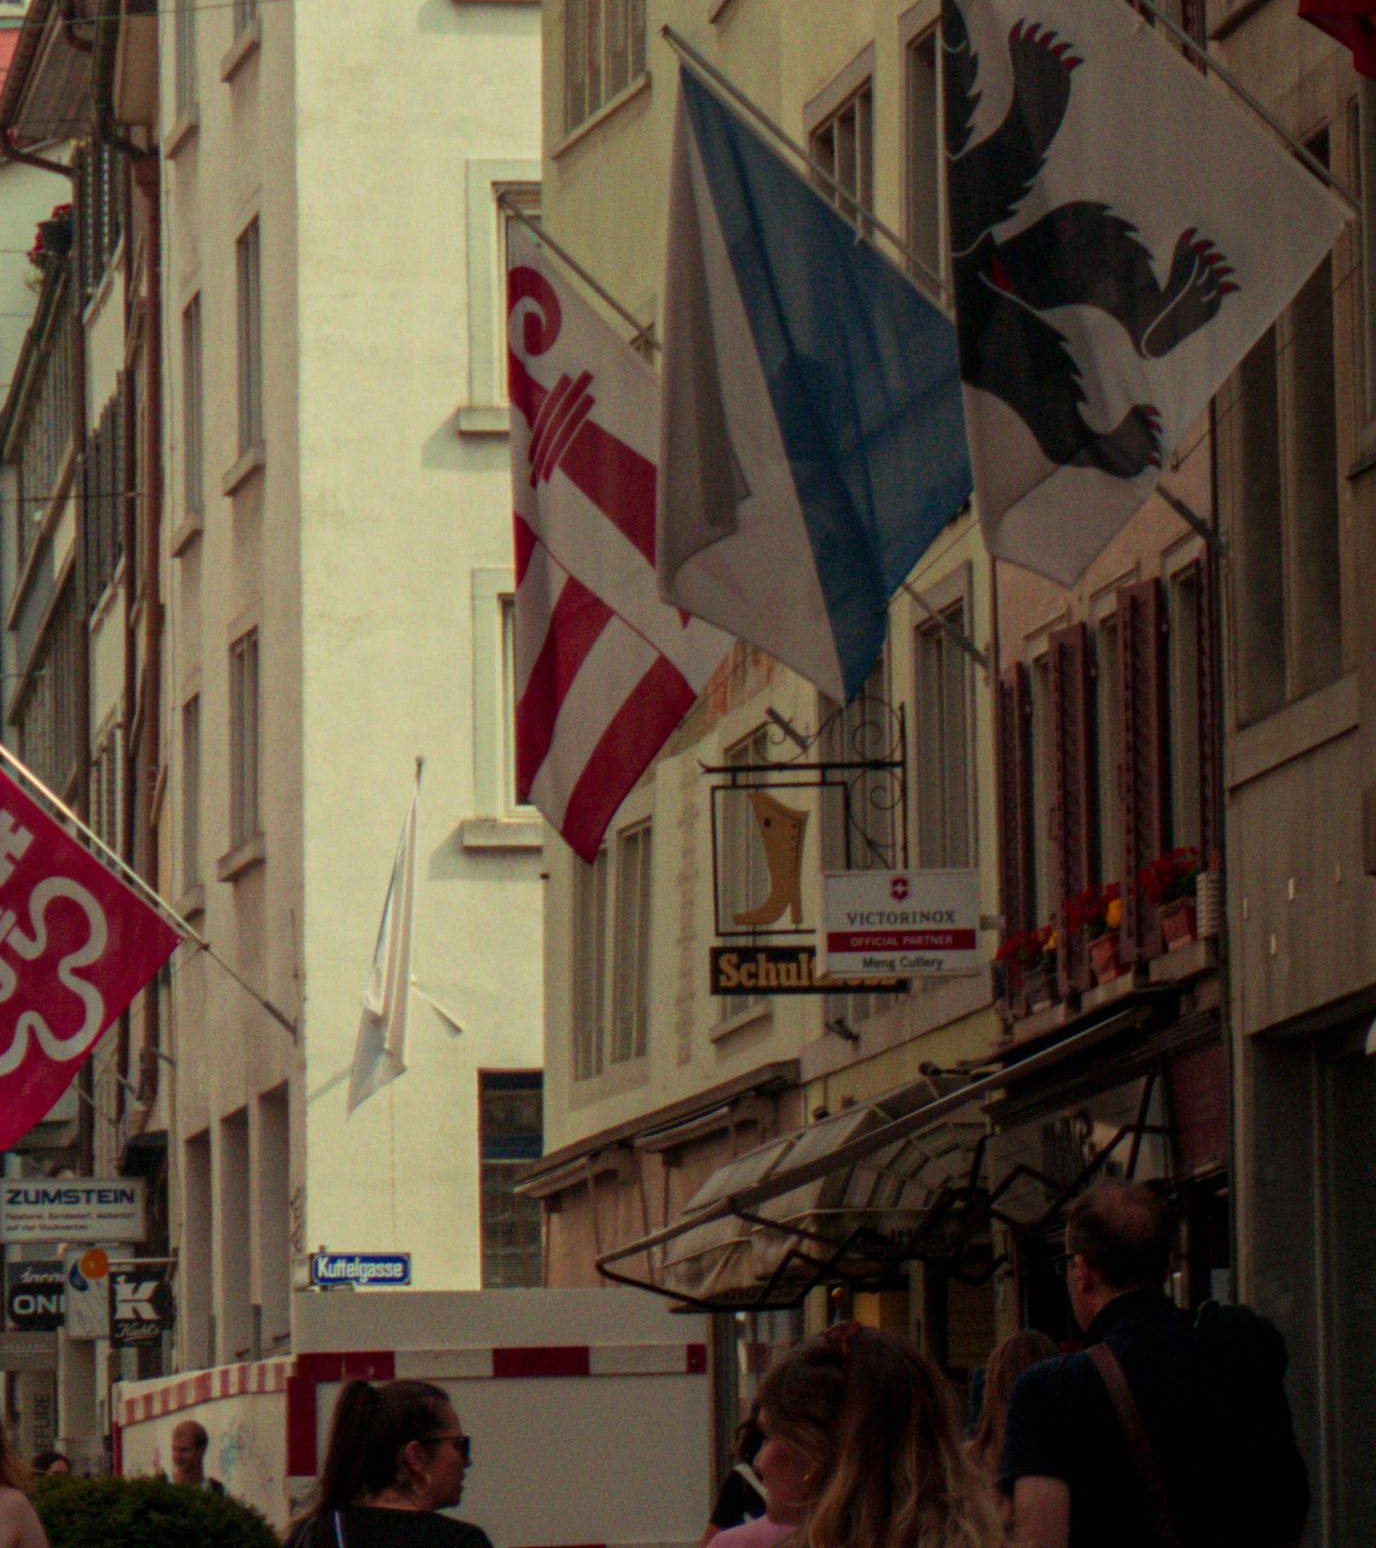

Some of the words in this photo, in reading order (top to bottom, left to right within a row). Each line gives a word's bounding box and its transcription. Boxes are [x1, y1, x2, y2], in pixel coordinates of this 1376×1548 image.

[847, 910, 956, 926] VICTORINOX
[850, 935, 899, 948] OFFICIAL
[902, 935, 954, 947] PARTNER
[862, 957, 896, 970] Meng
[900, 956, 943, 970] Cutlery
[6, 1189, 135, 1205] ZUMSTEIN
[317, 1256, 403, 1282] Kuttelgasse
